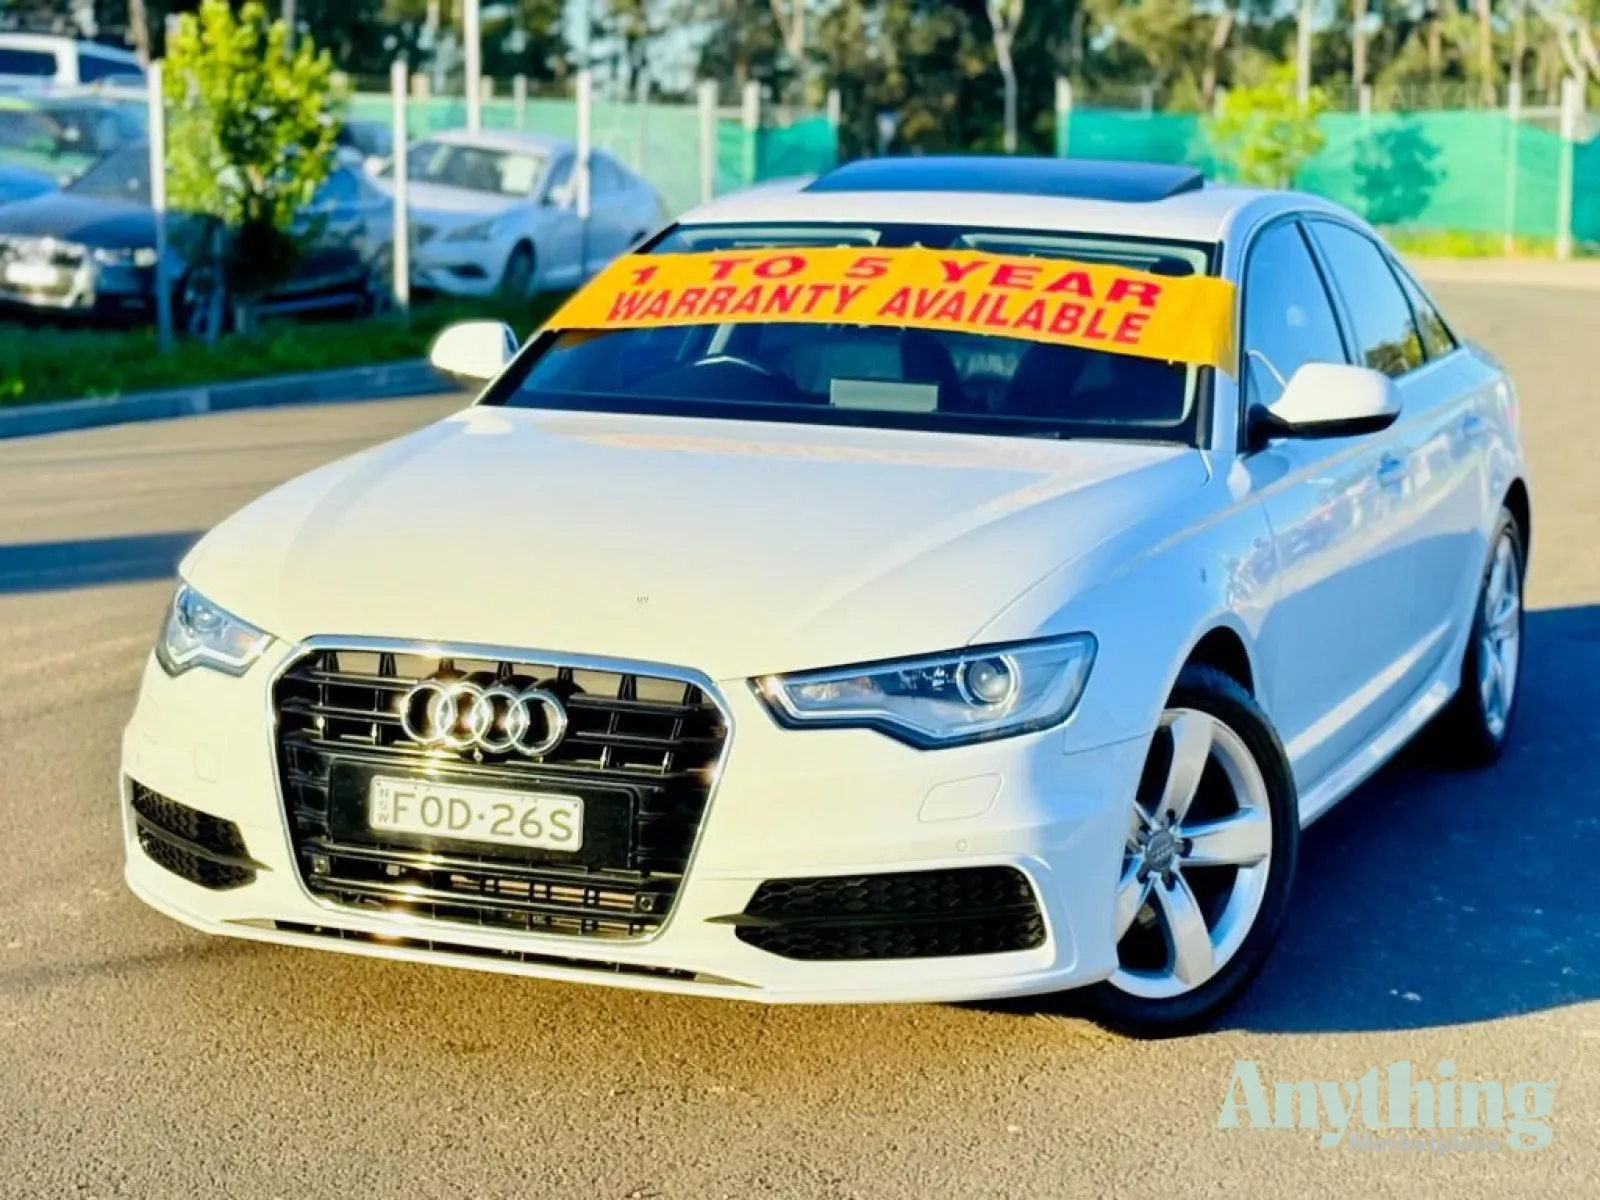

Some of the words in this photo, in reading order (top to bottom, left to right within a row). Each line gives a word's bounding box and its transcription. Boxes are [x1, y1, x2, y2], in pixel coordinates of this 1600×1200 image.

[632, 266, 660, 286] 1
[709, 256, 806, 280] TO
[846, 257, 889, 279] 5
[940, 258, 1163, 307] YEAR
[607, 285, 864, 322] WARRANTY
[878, 287, 1152, 345] AVAILABLE
